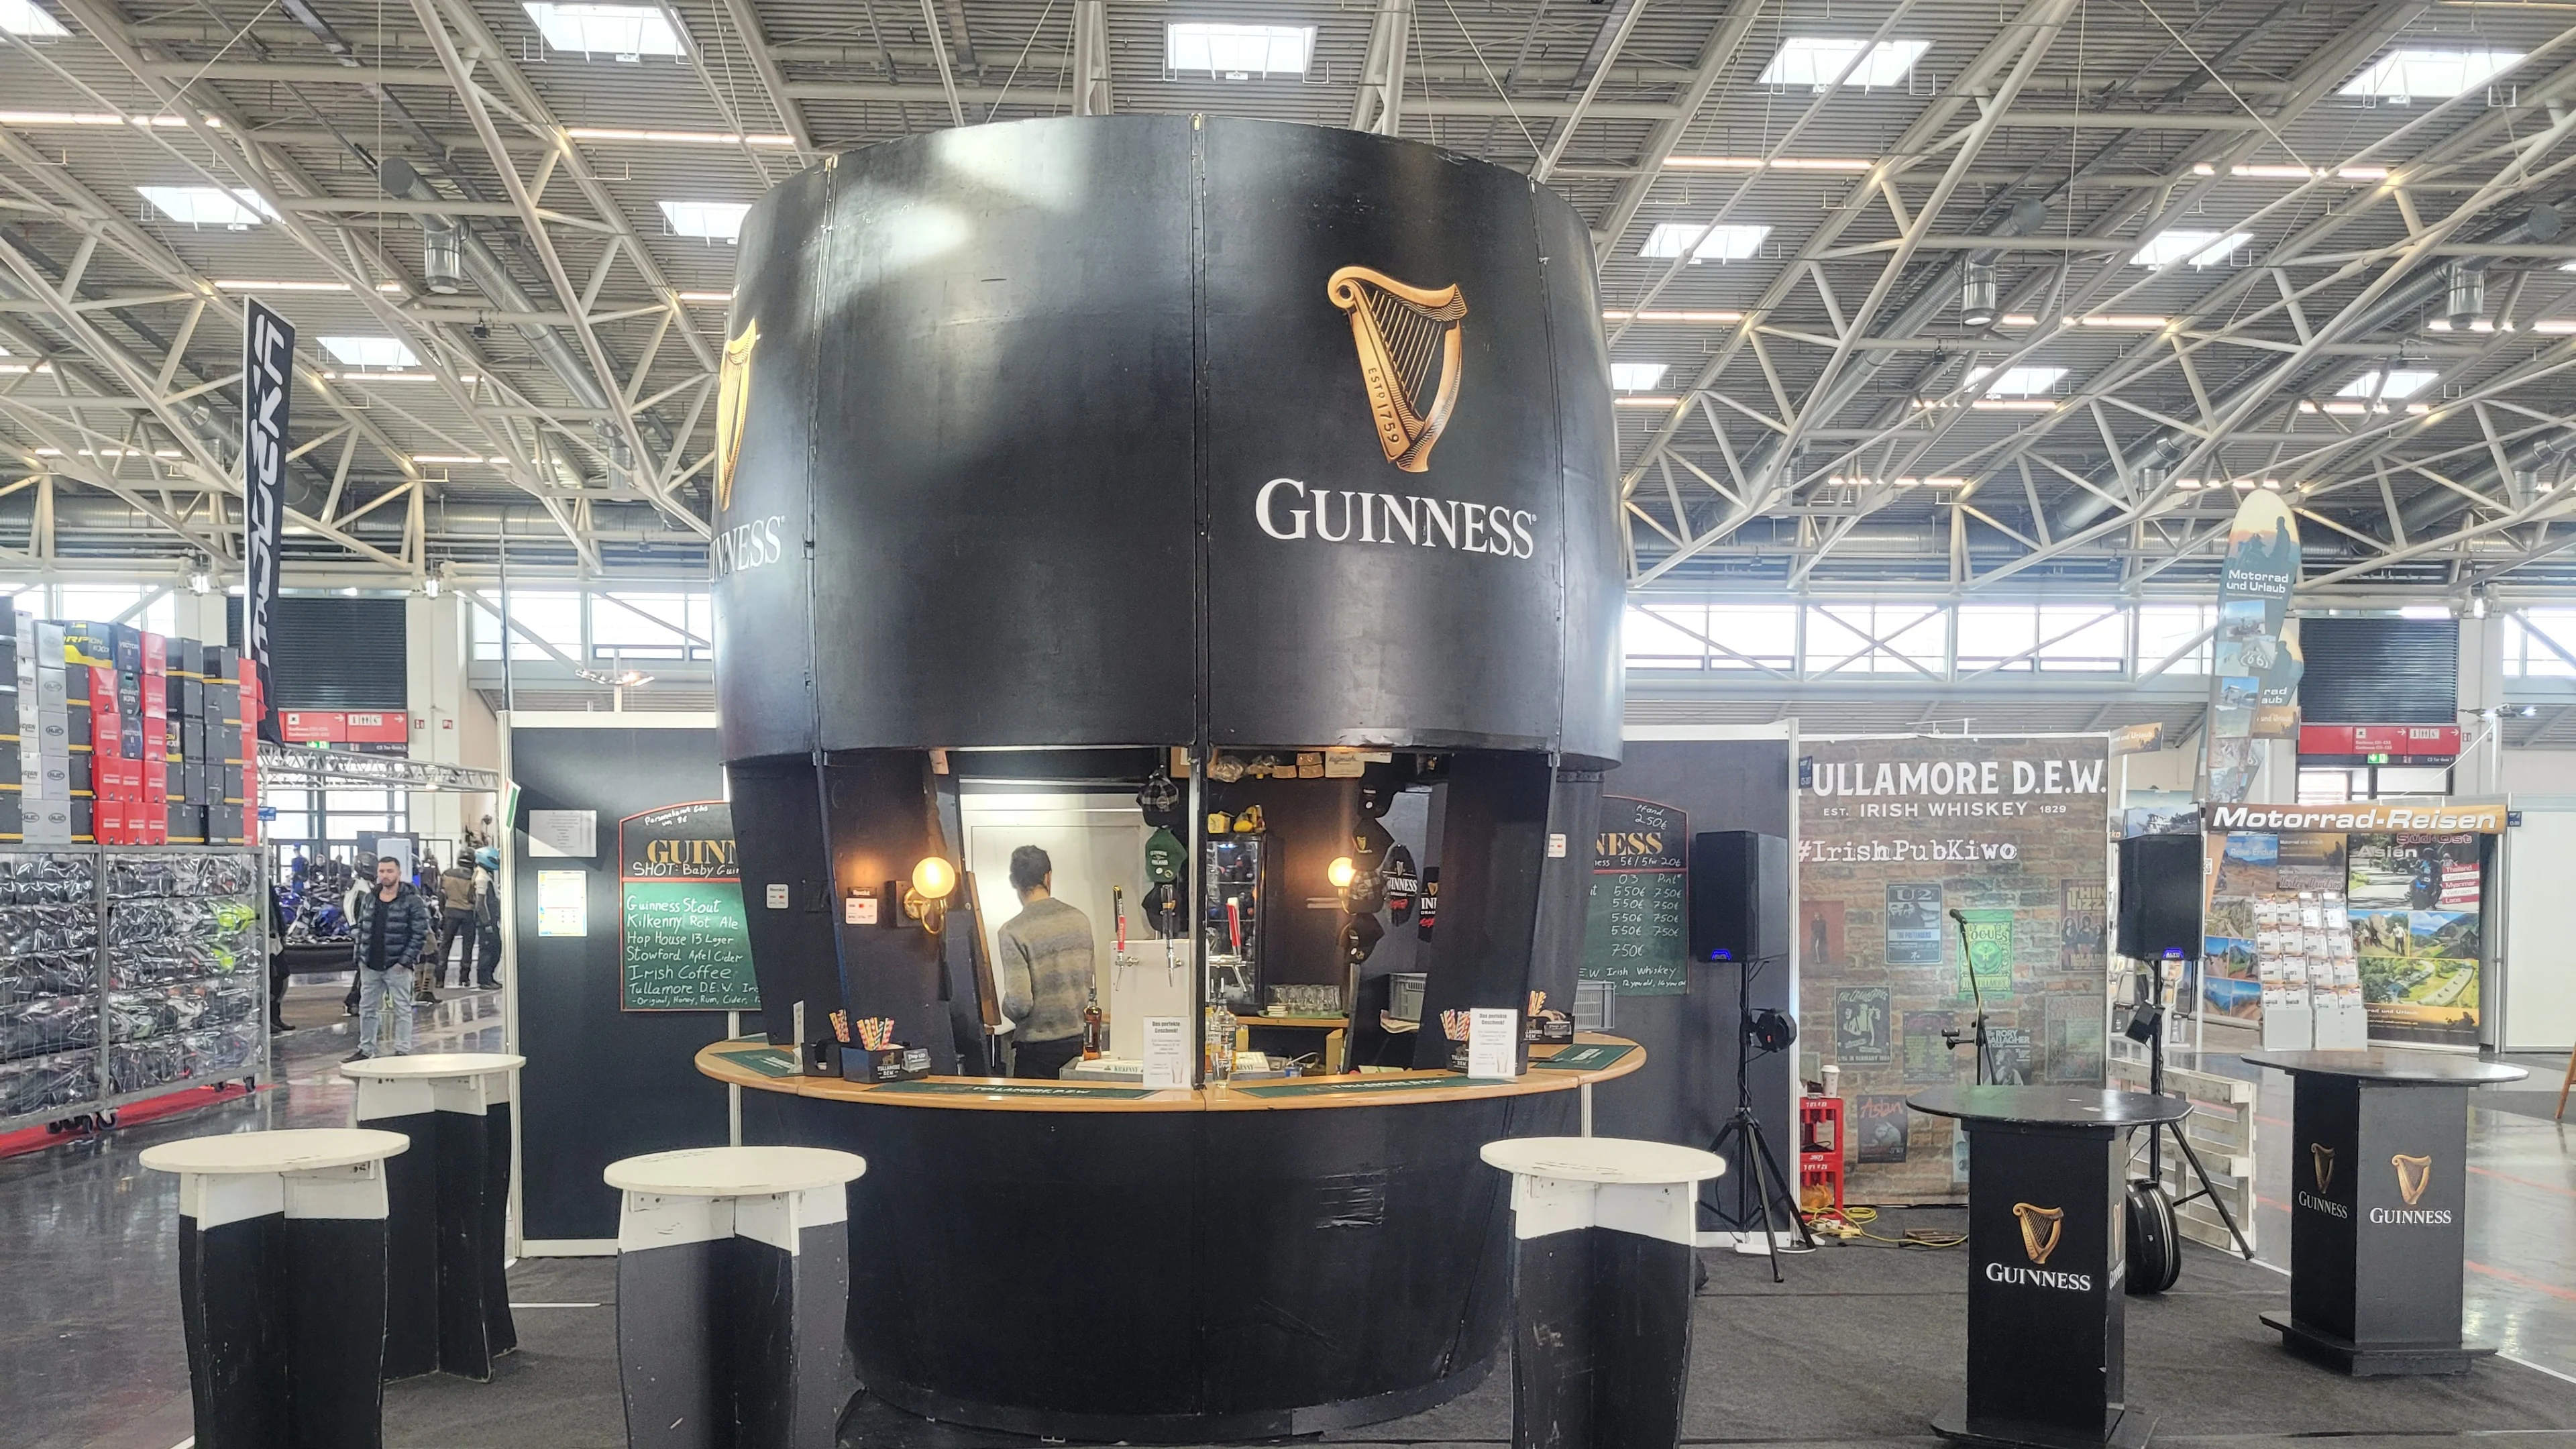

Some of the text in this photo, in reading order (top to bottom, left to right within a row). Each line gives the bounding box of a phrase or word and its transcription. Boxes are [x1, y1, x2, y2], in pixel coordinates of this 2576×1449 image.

[1377, 403, 1400, 443] 1759
[1255, 478, 1534, 560] GUINNESS
[2229, 569, 2289, 583] Motorrad
[2226, 581, 2286, 593] und Urlaub
[64, 636, 103, 645] RPION
[1805, 759, 2106, 797] ULLAMORE D.E.W.
[1823, 801, 2067, 818] EST. IRISH WHISKEY 1829
[2213, 806, 2497, 831] Motorrad-Reisen
[1798, 839, 2017, 863] #IrishPubKiwo
[2357, 845, 2418, 857] Asien
[682, 863, 714, 879] Baby
[2445, 865, 2473, 873] Thailand
[1896, 889, 1932, 902] U2
[627, 895, 722, 914] Guinness Stout
[627, 913, 739, 934] Kilkenny Rot Ale
[627, 930, 651, 947] Hop
[655, 930, 687, 946] House
[691, 932, 702, 945] 13
[627, 945, 682, 961] Stowford
[714, 951, 743, 963] Cider
[628, 964, 732, 981] Irish Coffee
[1606, 967, 1629, 977] Irish
[1636, 965, 1676, 979] Whiskey
[629, 981, 694, 995] Tullamore
[1995, 1029, 2019, 1038] RORY
[2298, 1191, 2347, 1220] GUINNESS
[2369, 1208, 2452, 1224] GUINNESS
[1986, 1263, 2091, 1291] GUINNESS
